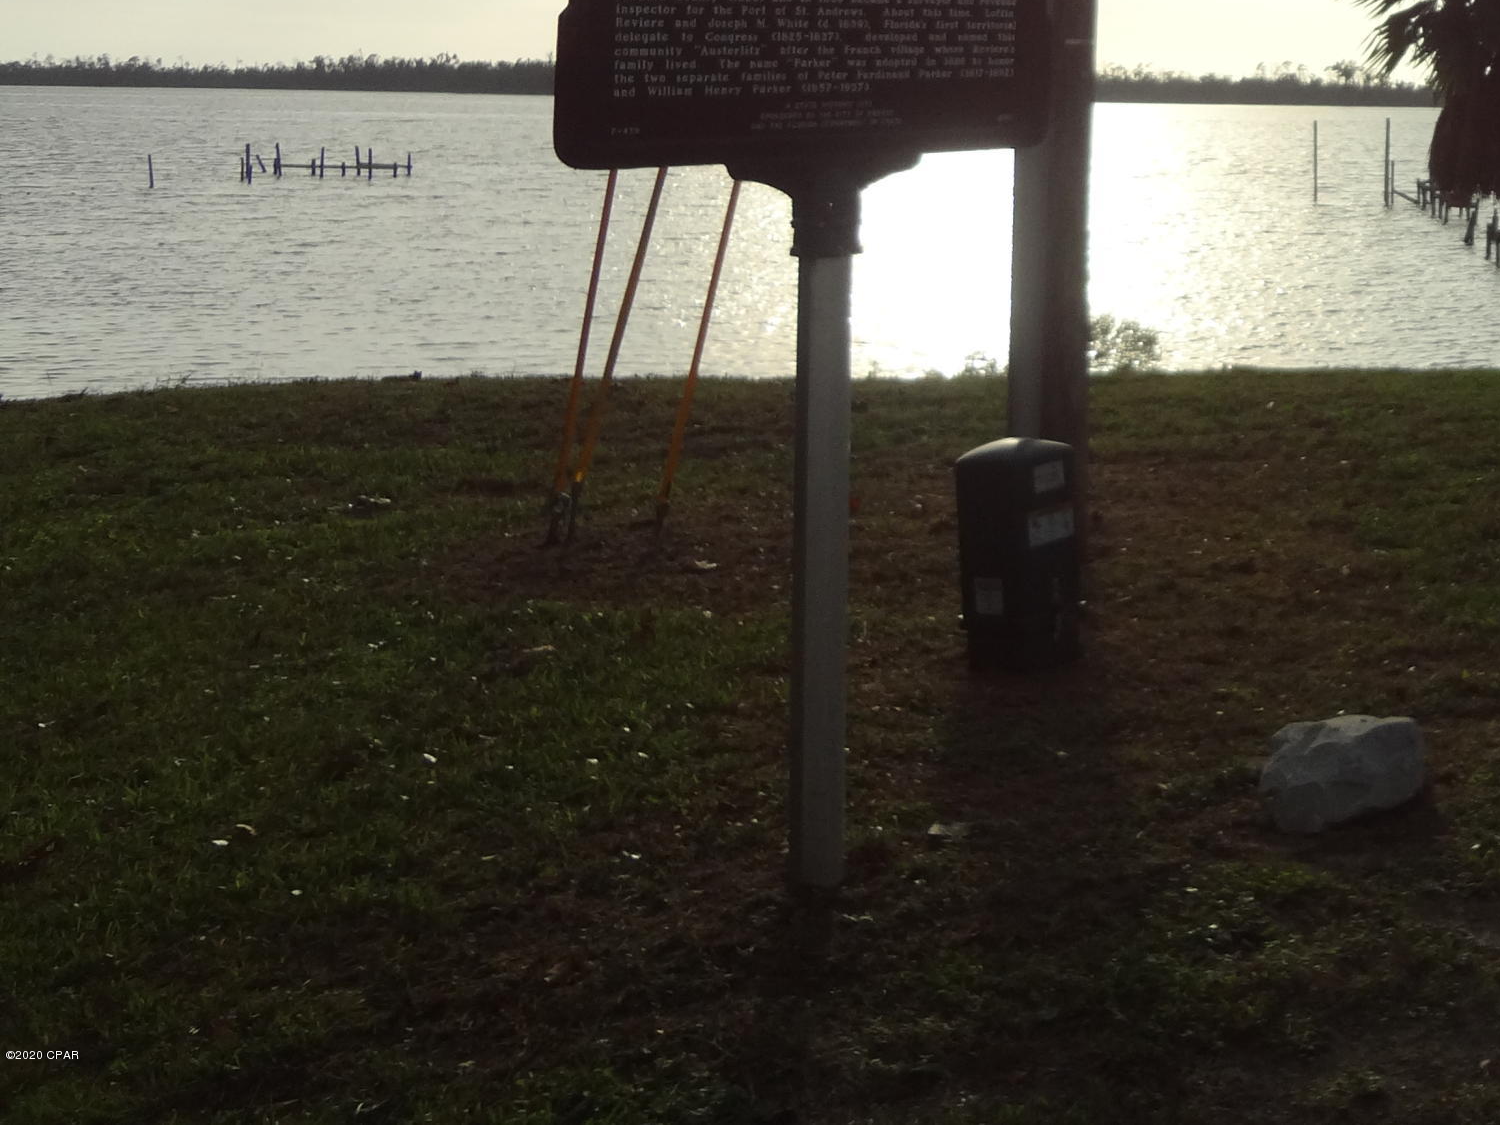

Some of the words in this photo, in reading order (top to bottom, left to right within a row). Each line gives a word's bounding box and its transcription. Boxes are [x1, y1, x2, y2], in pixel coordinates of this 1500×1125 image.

[615, 3, 676, 15] inspector
[686, 4, 704, 15] for
[712, 5, 732, 15] the
[741, 5, 766, 15] Port
[774, 5, 786, 15] of
[615, 17, 664, 27] Reviere
[674, 17, 696, 28] and
[707, 17, 747, 29] Joseph
[776, 18, 808, 28] White
[614, 31, 668, 43] delegate
[681, 32, 693, 42] to
[704, 31, 758, 43] Congress
[613, 46, 682, 56] community
[694, 45, 766, 56] "Austerlitz"
[779, 45, 808, 55] after
[613, 59, 653, 71] family
[719, 58, 740, 69] The
[749, 59, 778, 68] name
[614, 73, 634, 84] the
[644, 73, 665, 83] two
[676, 72, 728, 84] separate
[741, 71, 786, 81] families
[797, 71, 808, 80] of
[612, 86, 635, 99] and
[647, 84, 692, 97] William
[704, 84, 742, 96] Henry
[752, 83, 792, 94] Parker
